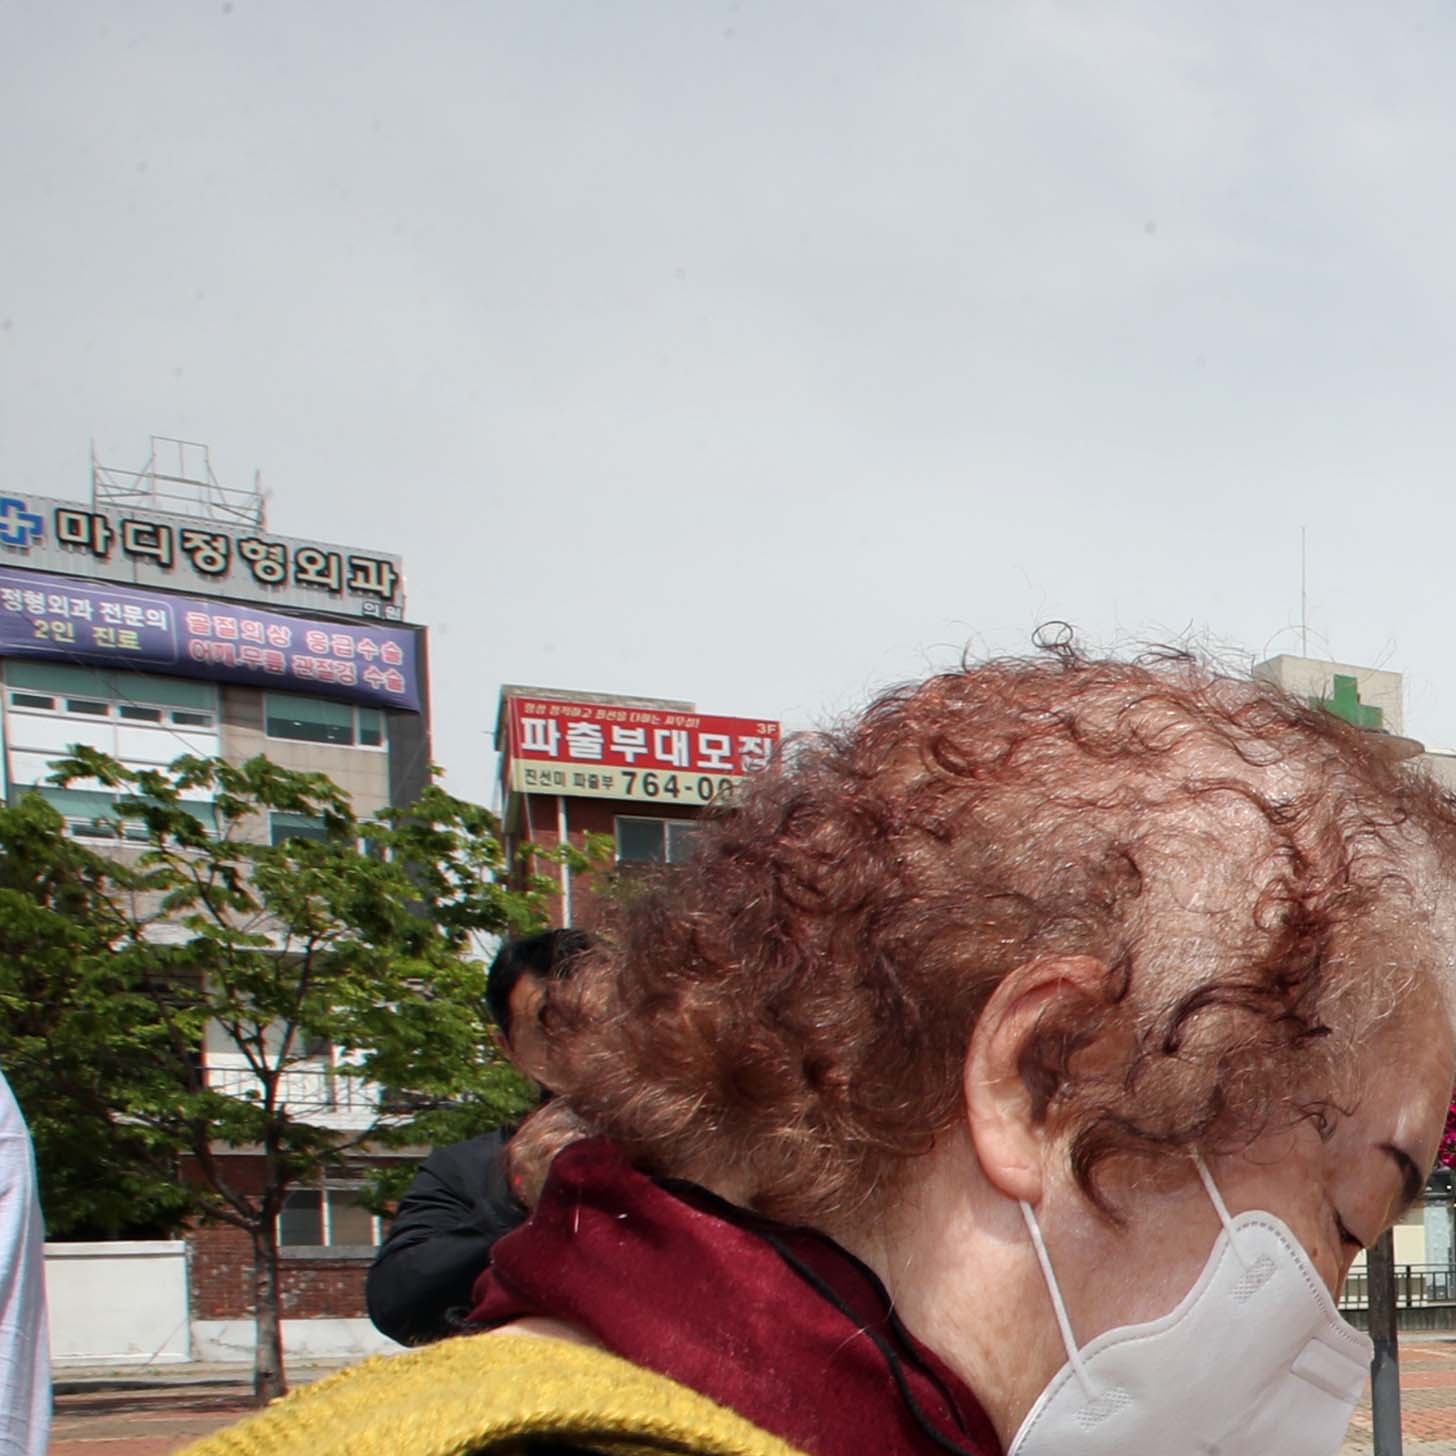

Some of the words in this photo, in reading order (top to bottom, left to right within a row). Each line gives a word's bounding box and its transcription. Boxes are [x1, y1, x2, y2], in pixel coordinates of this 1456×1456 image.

[55, 507, 401, 601] 마디정형외과
[0, 587, 94, 621] 정형외과
[99, 602, 168, 631] 전문의
[363, 602, 402, 620] 의원
[34, 619, 77, 643] 2인
[92, 626, 143, 650] 진료
[305, 630, 404, 666] 응급수술
[291, 654, 358, 687] 관절경
[361, 664, 406, 694] 수술
[520, 717, 773, 772] 파출부대모집
[756, 722, 777, 735] 3F
[524, 768, 566, 788] 진선미
[572, 772, 615, 790] 파출부
